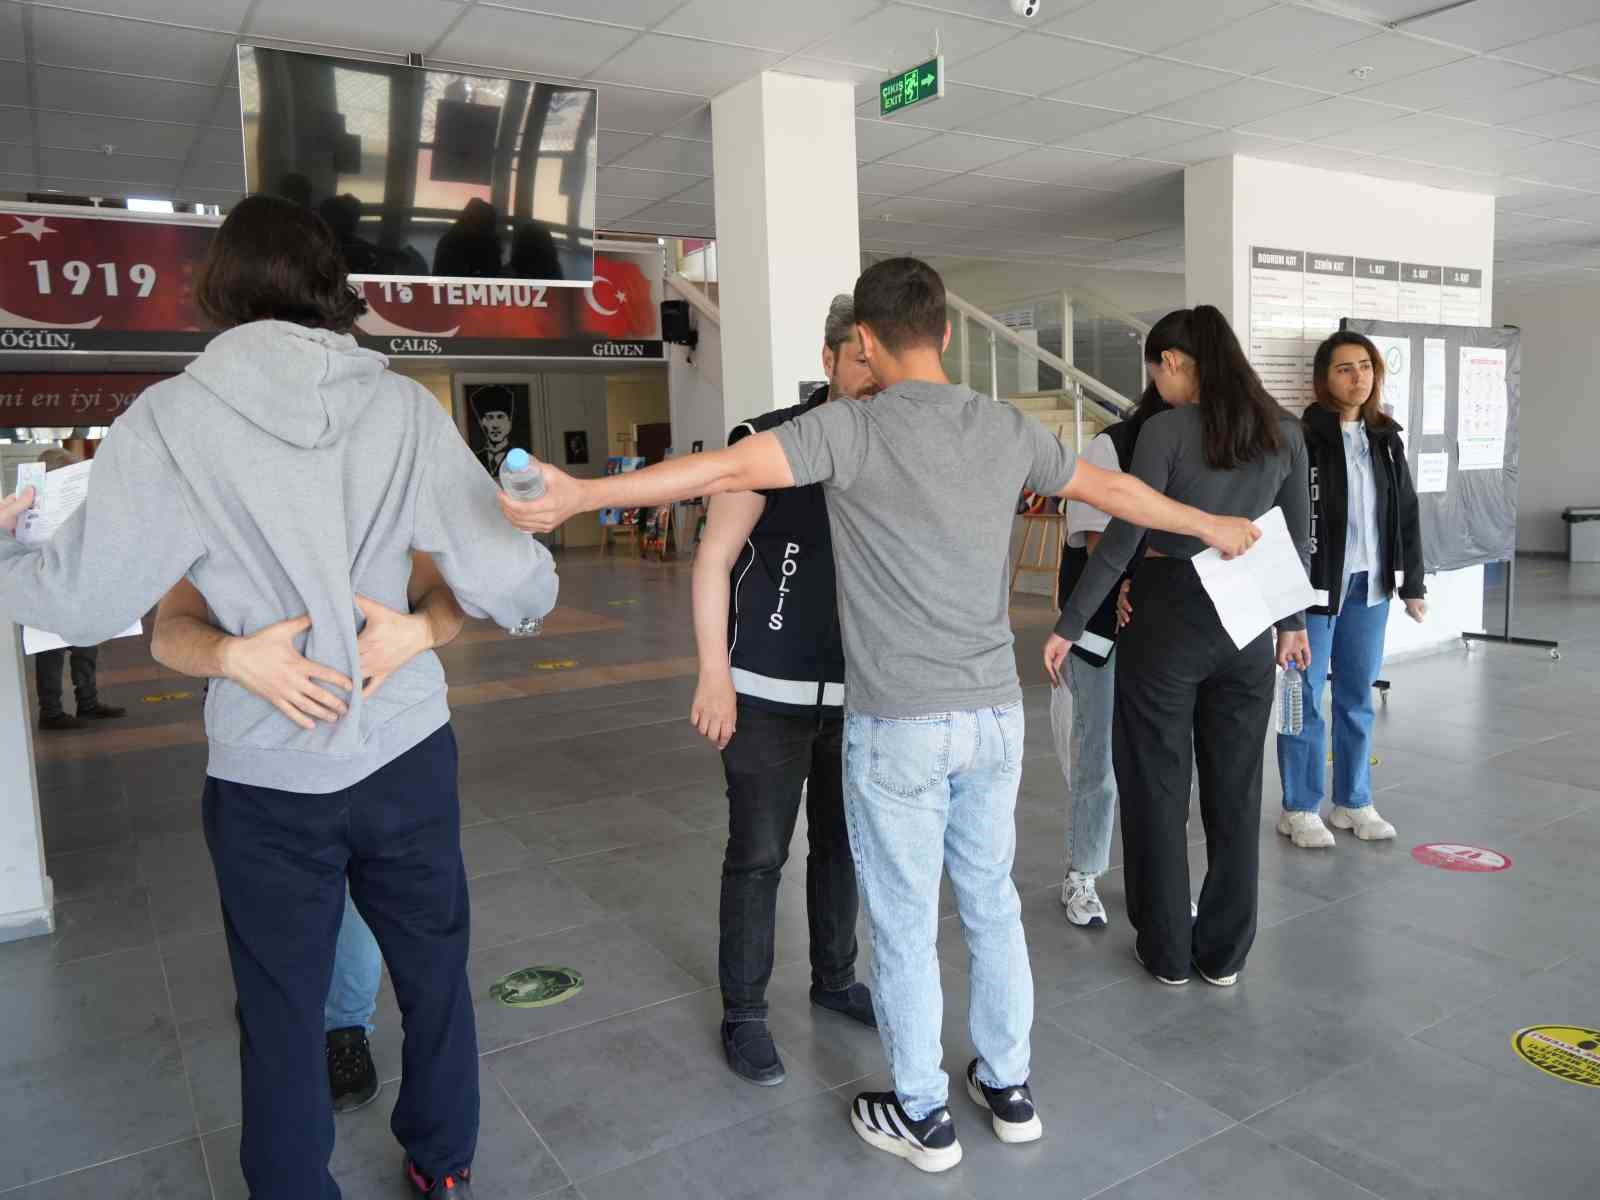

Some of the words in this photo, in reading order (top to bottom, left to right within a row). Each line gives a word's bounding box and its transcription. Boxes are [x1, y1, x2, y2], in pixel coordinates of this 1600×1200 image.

[885, 94, 902, 109] EXIT
[28, 259, 156, 298] 1919
[427, 283, 548, 308] TEMMUZ
[1, 330, 75, 349] ÖĞÜN,
[390, 337, 442, 354] ÇALIŞ,
[592, 341, 644, 357] GÜVEN
[32, 393, 61, 407] en
[71, 387, 103, 413] iyi
[768, 541, 800, 631] POLİS
